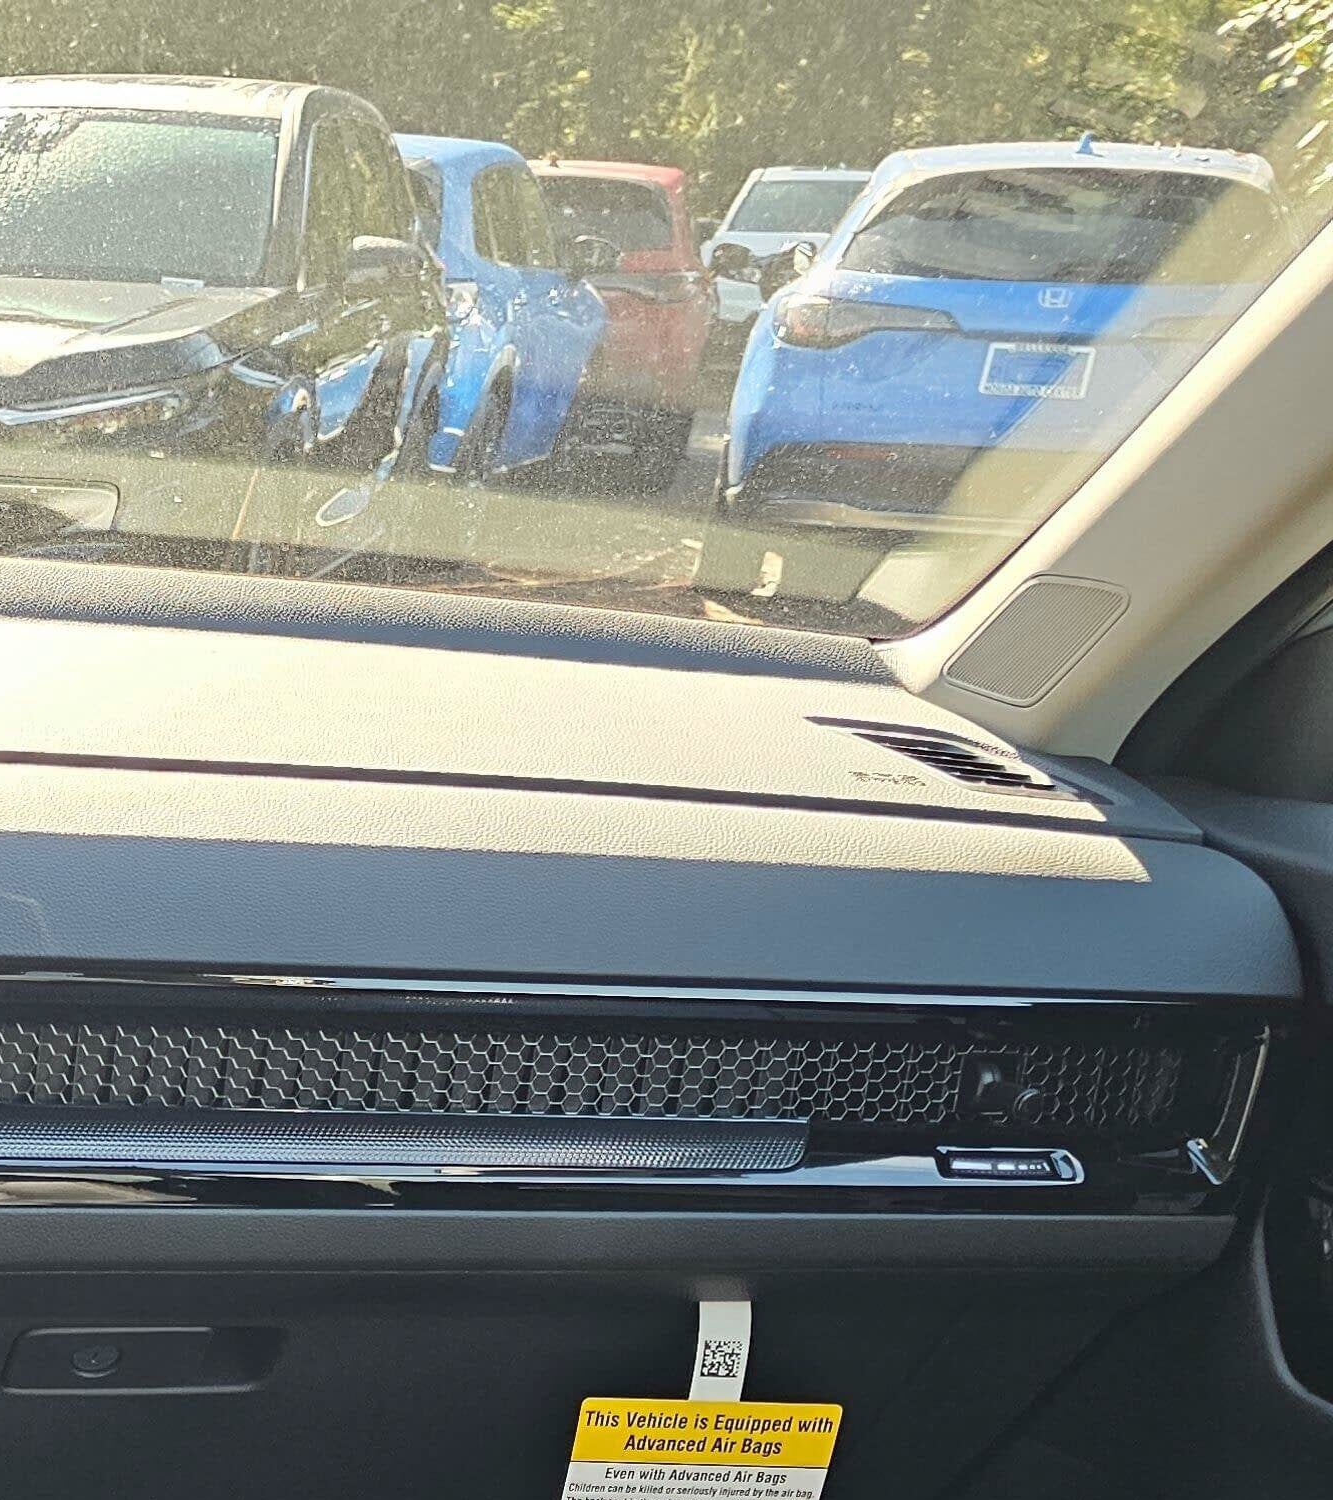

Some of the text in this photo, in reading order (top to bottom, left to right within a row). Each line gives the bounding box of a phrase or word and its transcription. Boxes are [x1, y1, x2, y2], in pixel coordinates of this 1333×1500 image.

[585, 1410, 833, 1434] This Vehicle is Equipped with
[624, 1434, 783, 1457] Advanced Air Bags
[605, 1467, 787, 1486] Even with Advanced Air Bags
[568, 1483, 815, 1499] Children can be killed or seriously injured by the air bag.
